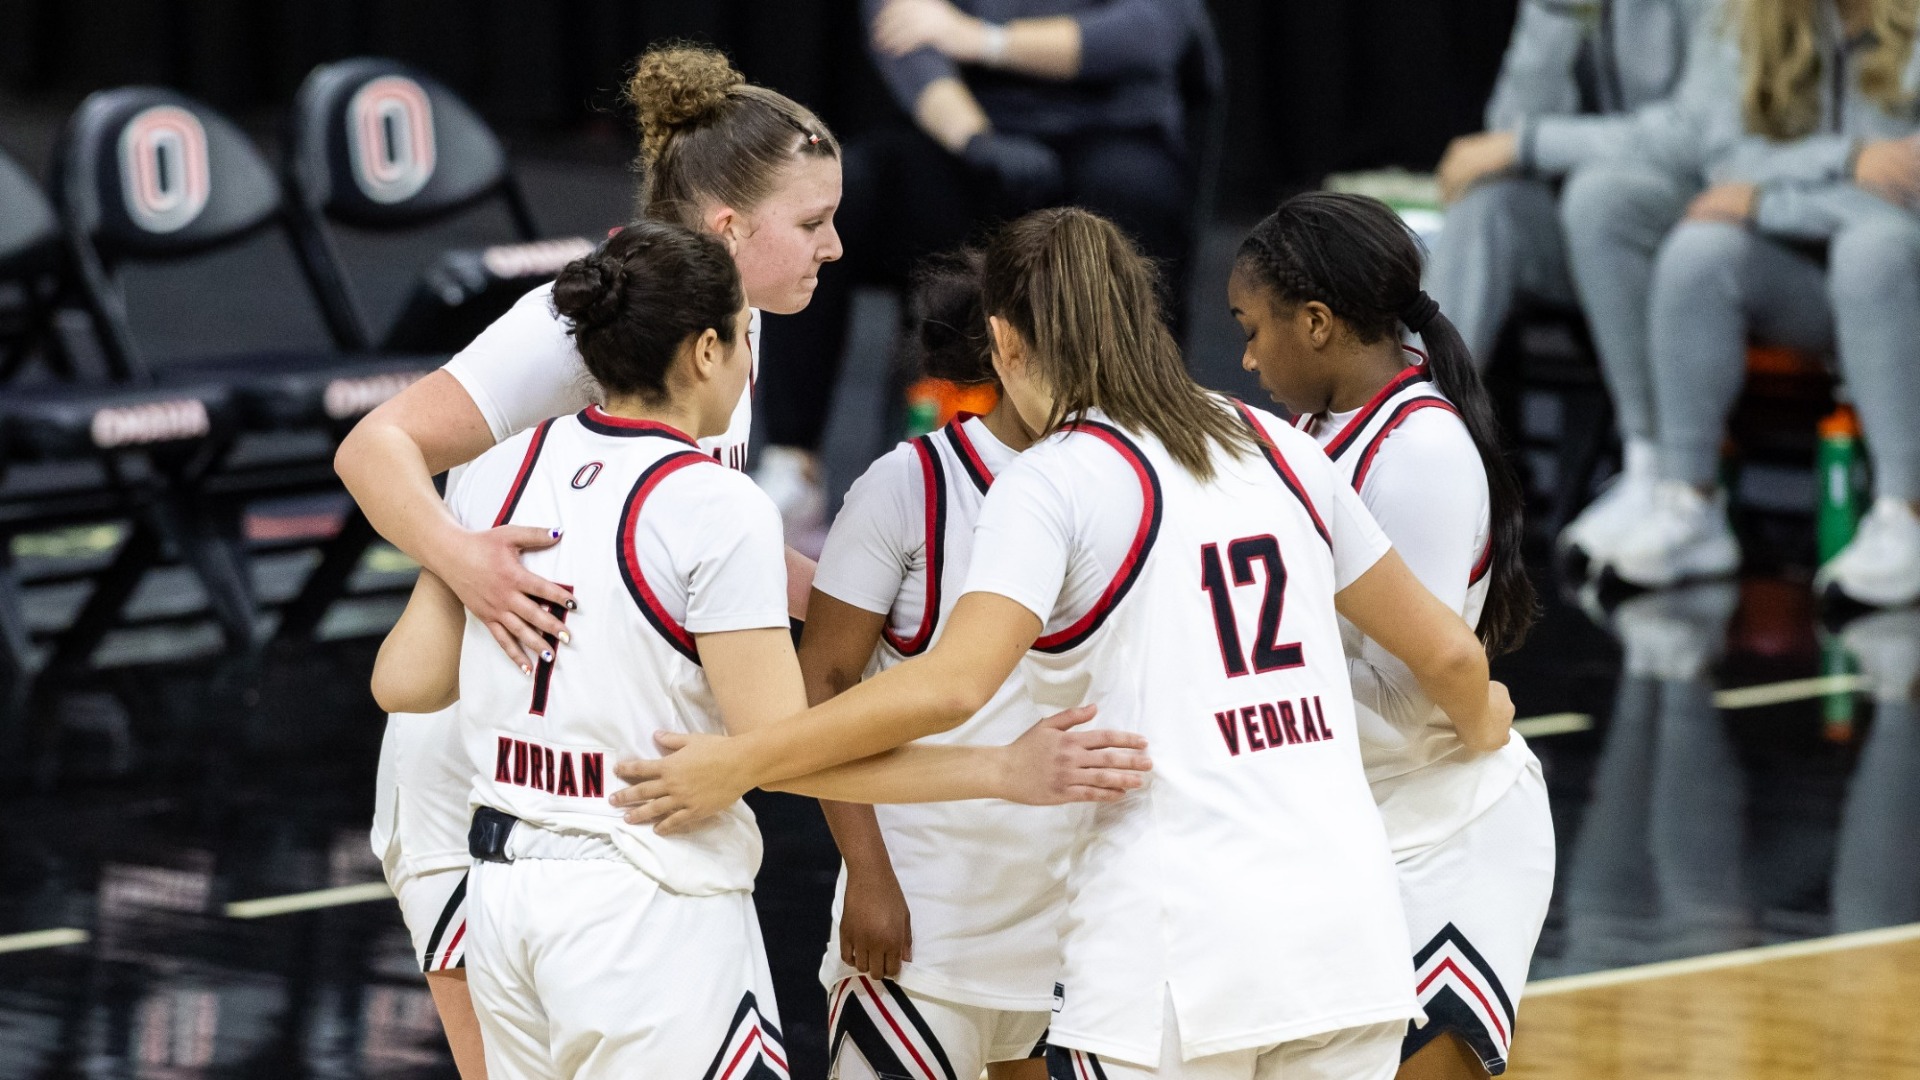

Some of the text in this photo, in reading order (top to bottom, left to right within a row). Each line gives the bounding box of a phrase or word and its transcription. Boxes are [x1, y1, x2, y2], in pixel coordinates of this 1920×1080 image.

[1201, 534, 1305, 678] 12
[1214, 696, 1334, 756] VEDRAL
[495, 736, 604, 798] KURBAN
